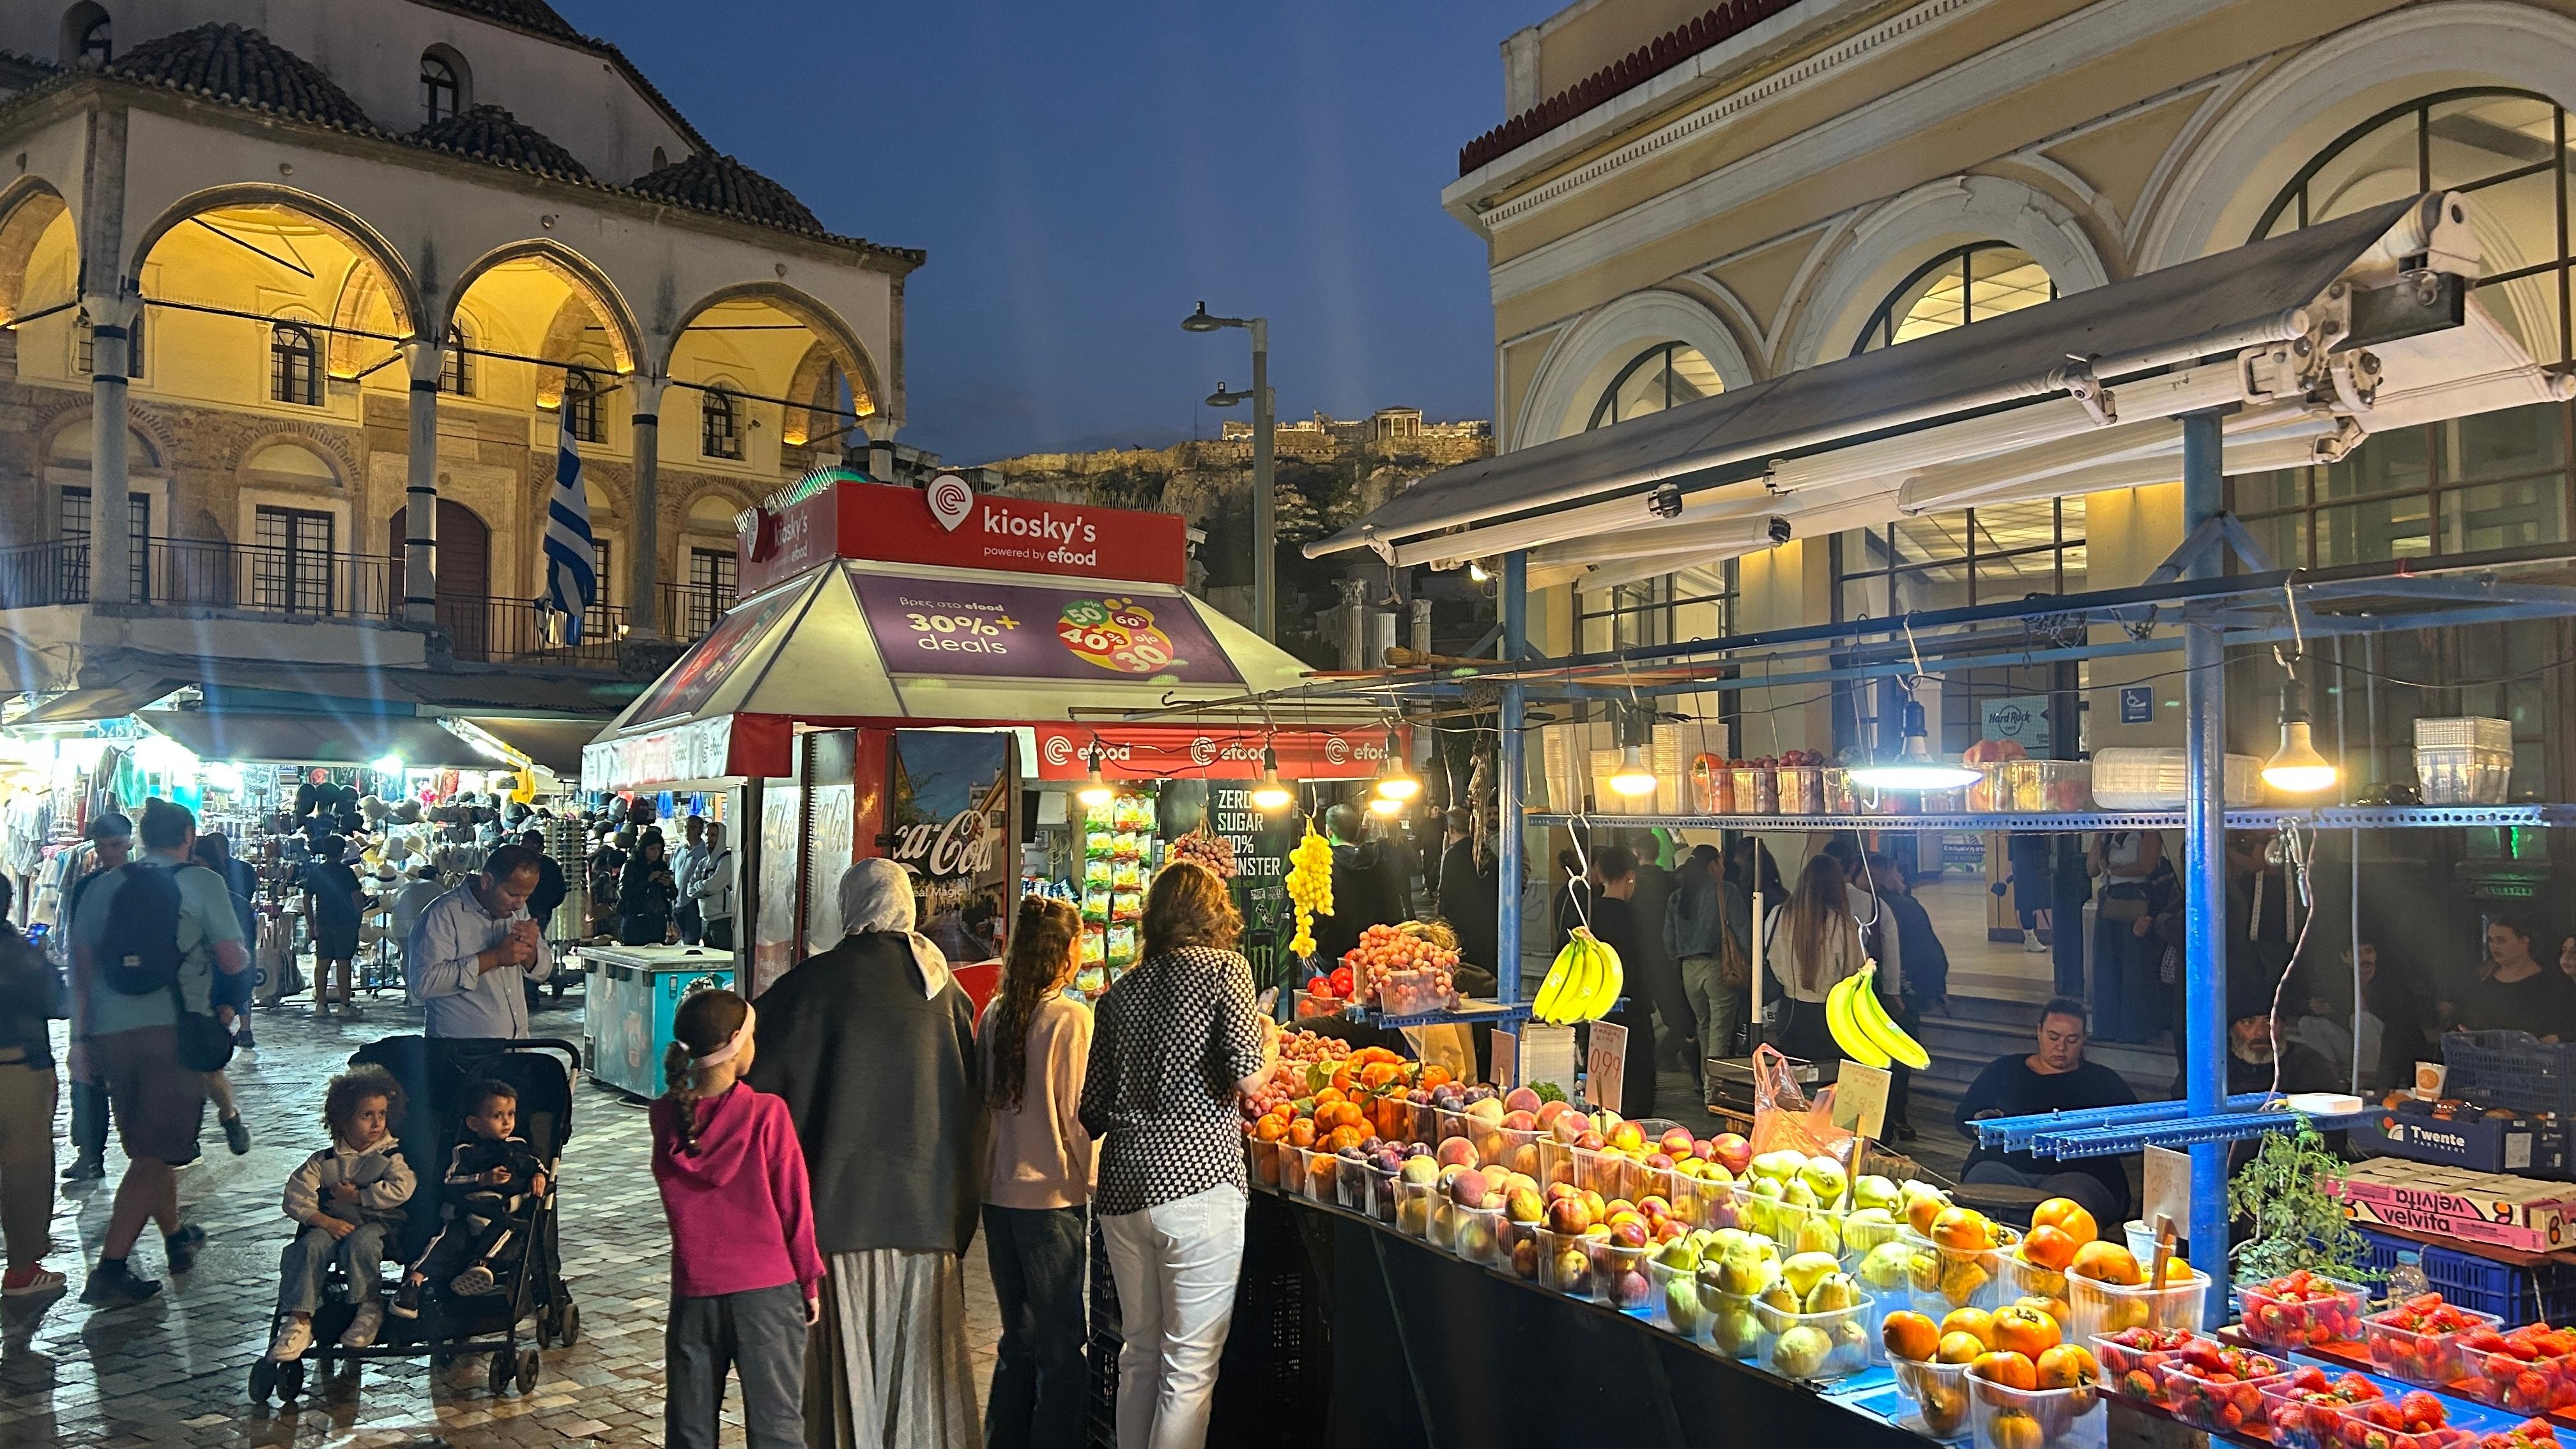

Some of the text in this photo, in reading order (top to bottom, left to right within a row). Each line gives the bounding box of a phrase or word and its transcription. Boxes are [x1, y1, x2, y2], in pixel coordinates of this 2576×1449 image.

[774, 510, 808, 548] kiosky's
[984, 505, 1096, 544] kiosky's
[984, 546, 1096, 566] powered by efood
[900, 597, 934, 608] βρες
[965, 602, 1004, 611] efood
[917, 634, 1008, 654] deals
[1989, 711, 2030, 724] Hard Rock
[1218, 790, 1252, 809] ZERO
[1218, 813, 1264, 831] SUGAR
[933, 887, 963, 898] Magic
[2411, 1125, 2465, 1147] Twente
[2395, 1188, 2464, 1214] velvita
[2383, 1208, 2451, 1233] velvita
